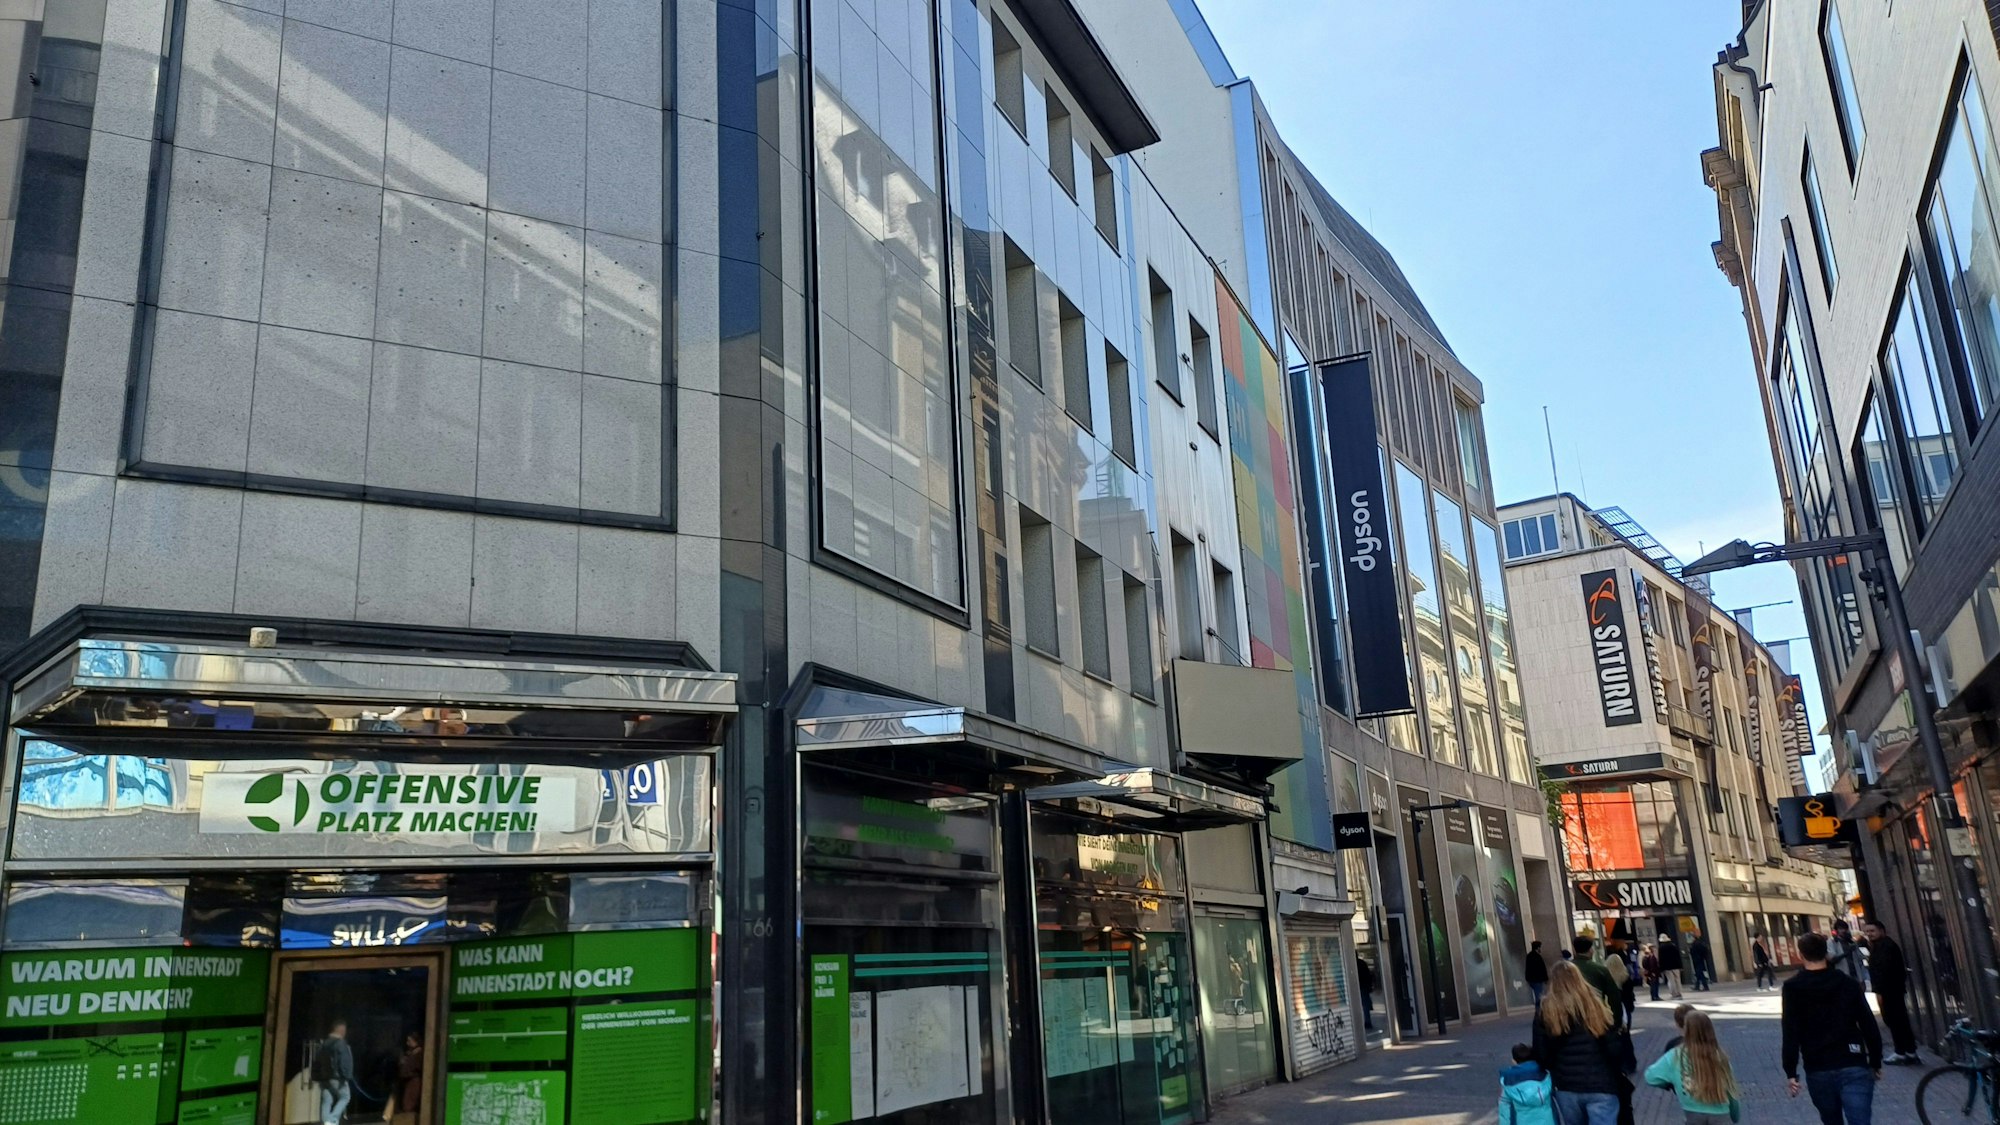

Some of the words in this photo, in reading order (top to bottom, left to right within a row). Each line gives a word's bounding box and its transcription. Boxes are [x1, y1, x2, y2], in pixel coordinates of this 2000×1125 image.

[1350, 490, 1381, 572] dyson
[1594, 624, 1635, 718] SATURN
[1781, 719, 1806, 786] SATURN
[1582, 760, 1618, 774] SATURN
[320, 774, 541, 804] OFFENSIVE
[317, 811, 401, 832] PLATZ
[409, 811, 537, 833] MACHEN!
[1340, 826, 1365, 836] dyson
[1087, 836, 1101, 850] SIEHT
[1102, 838, 1117, 852] DEINE
[1617, 879, 1693, 907] SATURN
[753, 917, 773, 937] 66
[458, 948, 493, 967] WAS
[496, 943, 543, 964] KANN
[11, 957, 136, 984] WARUM
[144, 956, 243, 978] INNENSTADT
[457, 971, 556, 995] INNENSTADT
[559, 966, 634, 990] NOCH?
[6, 993, 72, 1018] NEU
[78, 987, 193, 1015] DENKEN?
